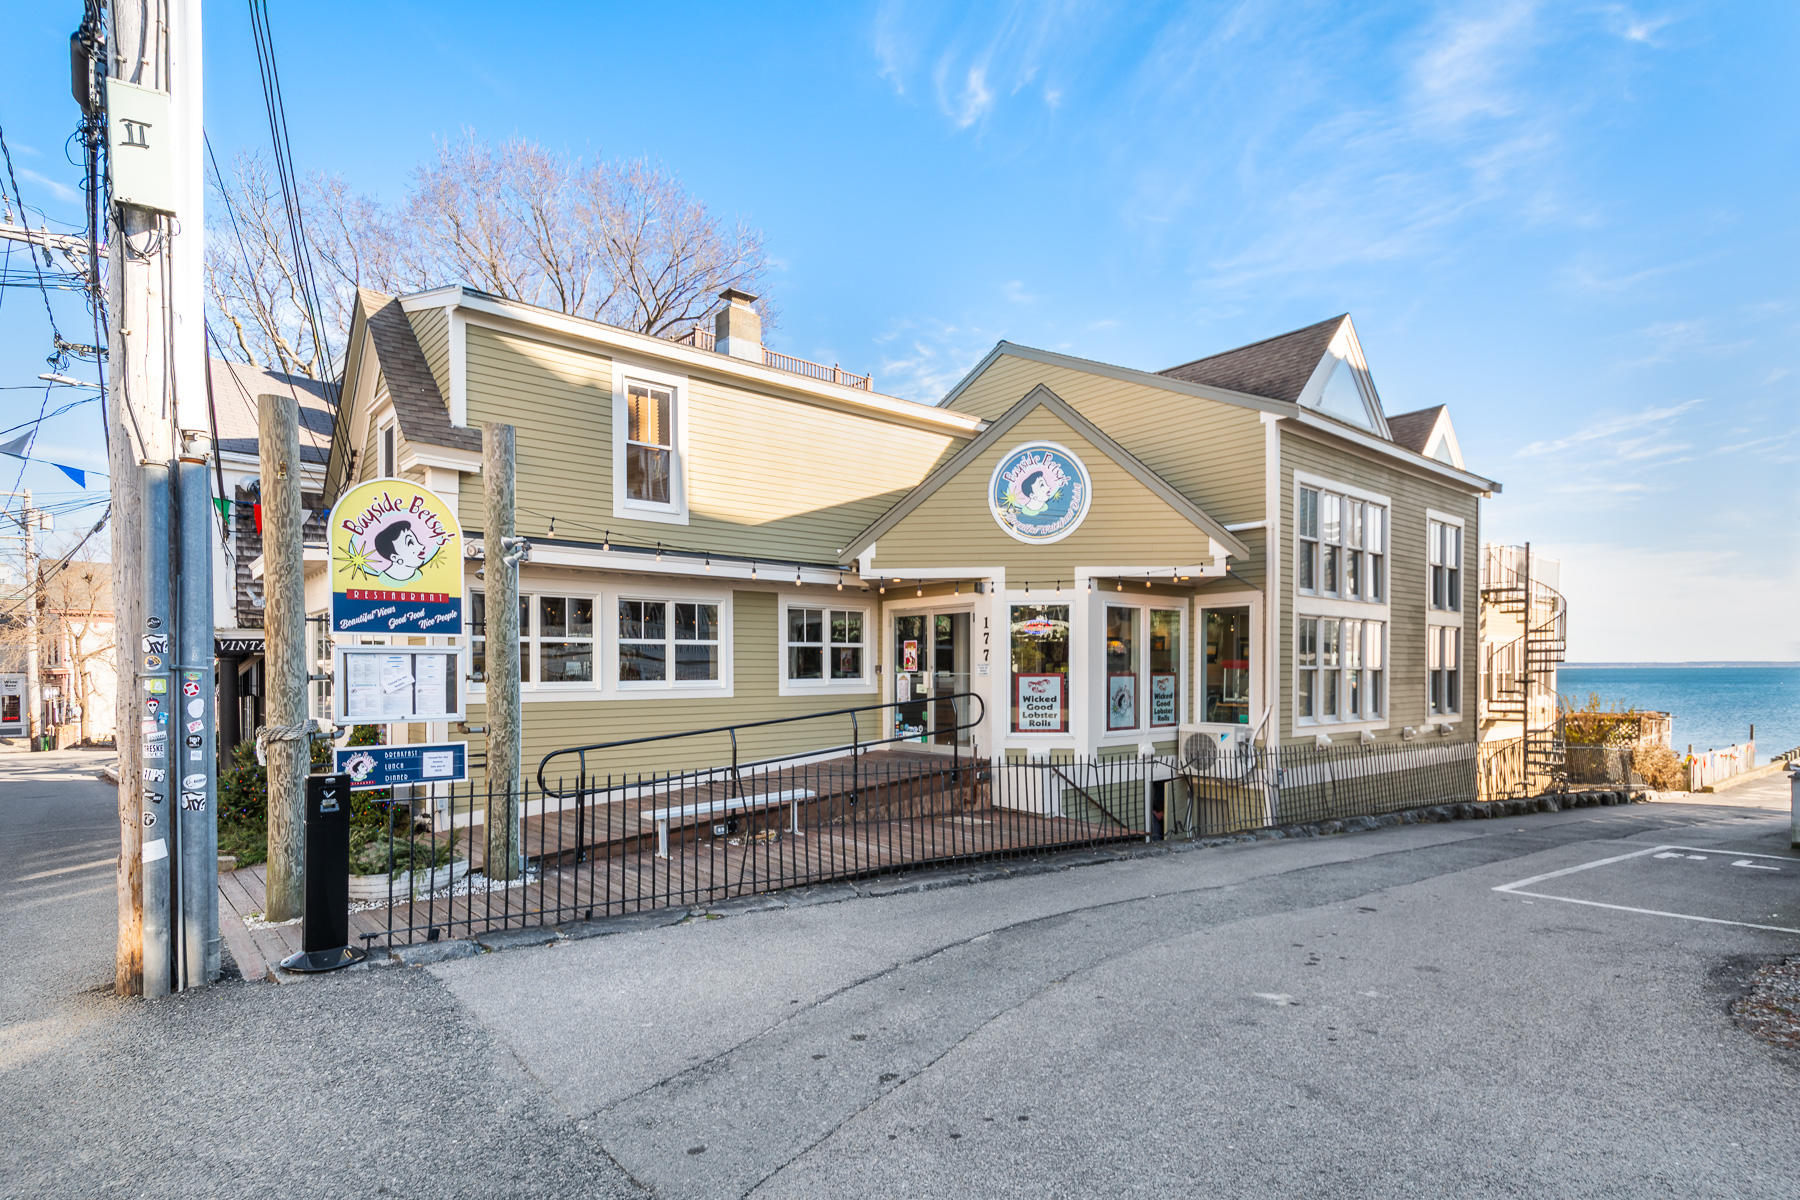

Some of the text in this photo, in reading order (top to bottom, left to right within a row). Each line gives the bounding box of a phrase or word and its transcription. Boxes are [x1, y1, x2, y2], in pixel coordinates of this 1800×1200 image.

[342, 492, 455, 546] Bayside Betsy's
[354, 590, 443, 602] RESTAURANT
[340, 605, 396, 630] Beautiful Views
[388, 607, 426, 630] Good Food
[418, 609, 458, 630] Nice People
[1022, 695, 1057, 703] Wicked
[1154, 692, 1173, 700] Wicked
[1026, 703, 1054, 711] Good
[1022, 711, 1058, 719] Lobster
[1028, 719, 1051, 727] Rolls
[384, 750, 418, 759] BREAKFAST
[385, 774, 408, 782] DINNER
